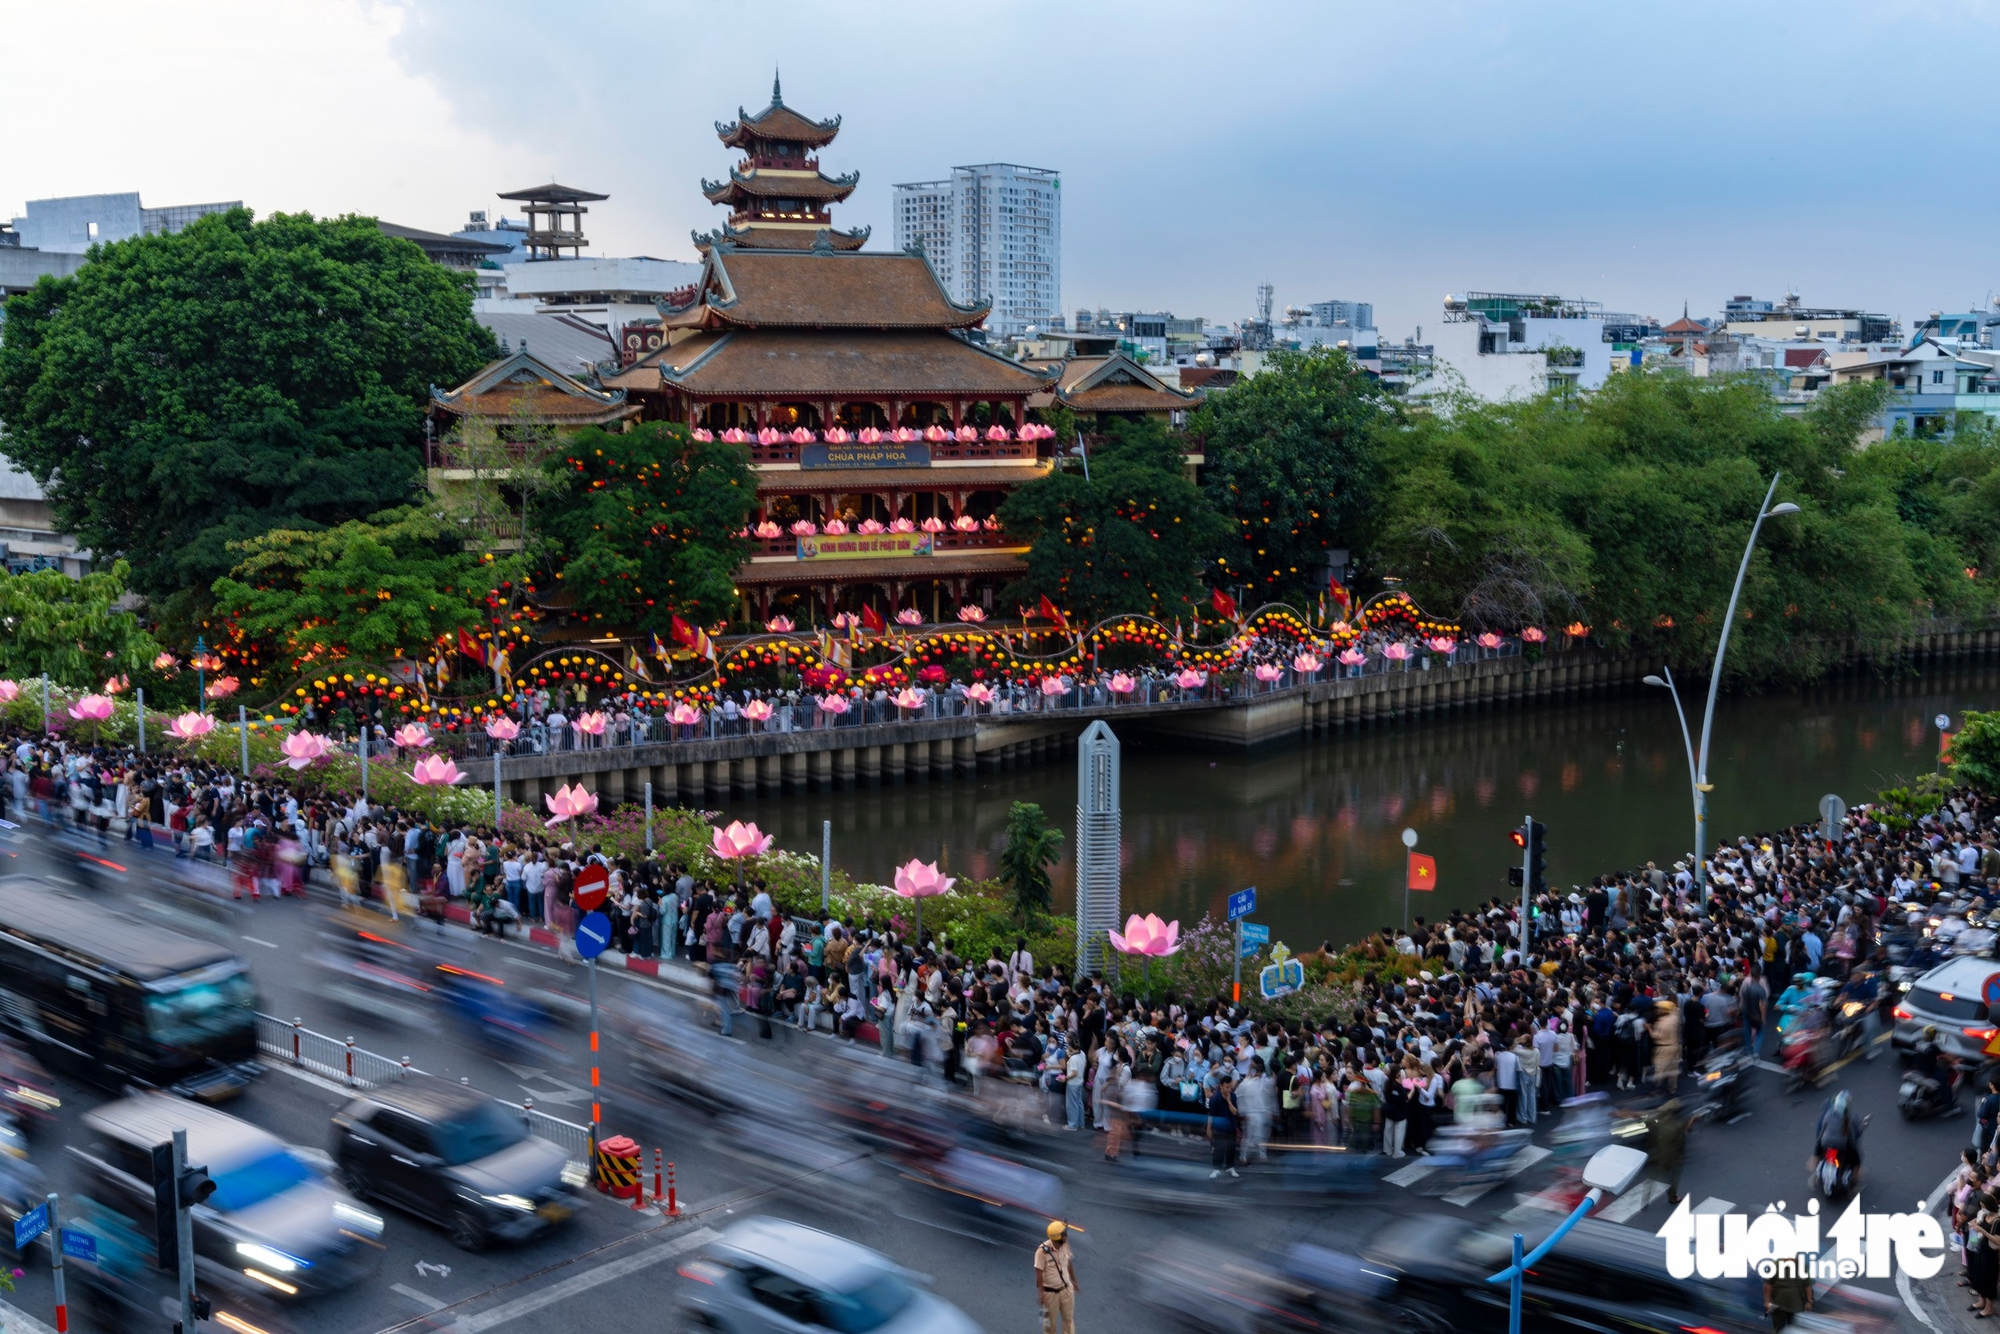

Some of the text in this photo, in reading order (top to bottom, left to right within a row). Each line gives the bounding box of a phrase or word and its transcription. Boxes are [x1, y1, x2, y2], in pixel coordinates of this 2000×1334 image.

[828, 450, 906, 461] CHÙA PHÁP HOA
[37, 1219, 46, 1231] SA
